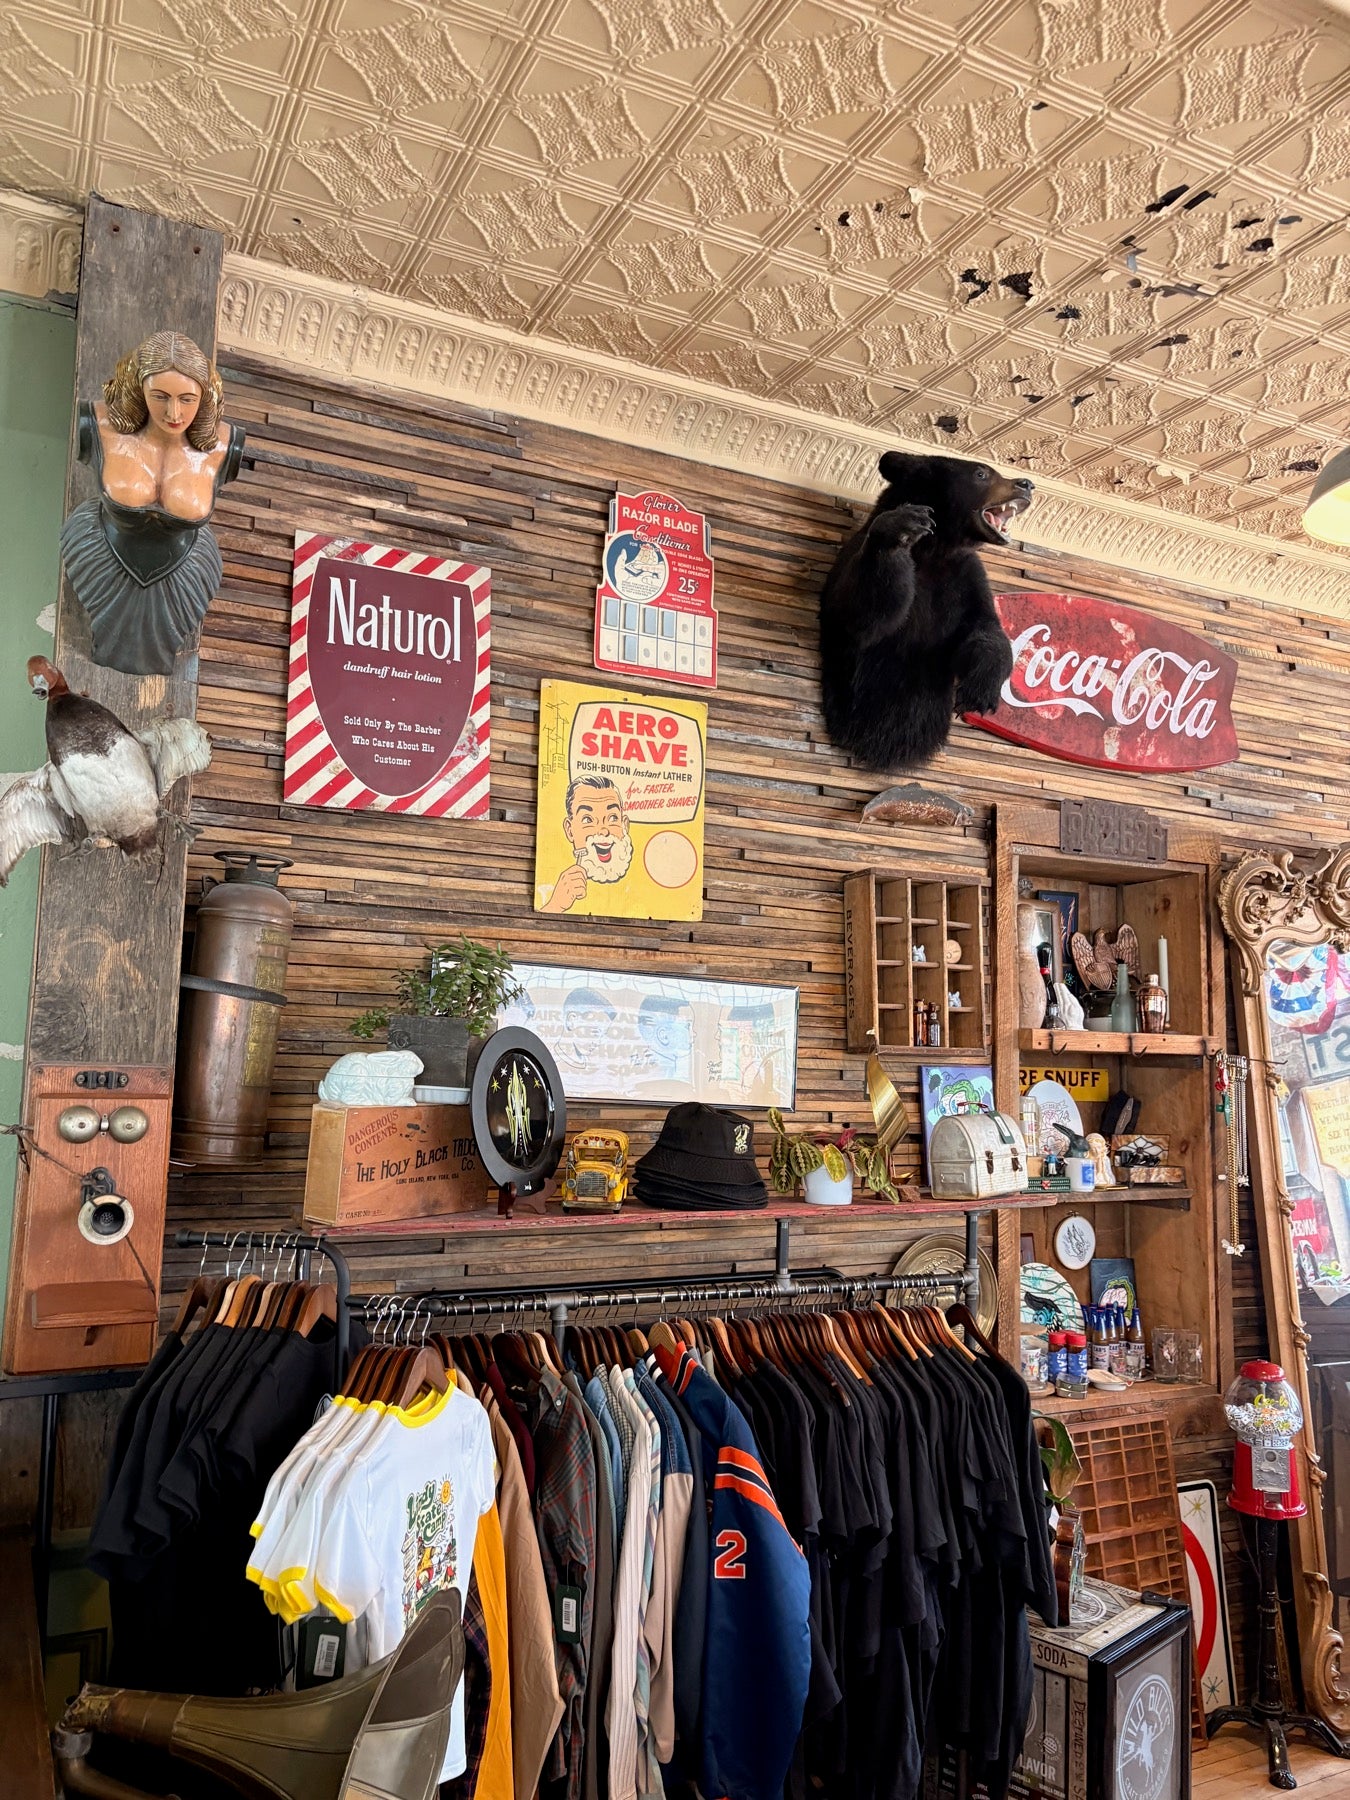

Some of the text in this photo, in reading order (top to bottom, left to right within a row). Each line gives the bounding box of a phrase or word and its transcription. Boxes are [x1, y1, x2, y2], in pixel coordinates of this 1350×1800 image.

[622, 507, 698, 534] RAZOR BLADE
[633, 524, 690, 551] Conditioner
[327, 577, 462, 662] Naturol
[343, 662, 442, 684] dandruff hair lotion
[1001, 624, 1220, 739] Coca-Cola
[344, 715, 442, 736] Sold Only By The Barber
[592, 708, 678, 739] AERO
[352, 735, 435, 753] Who Cares About His
[581, 732, 688, 767] SHAVE
[374, 754, 412, 766] Customer
[576, 760, 693, 783] PUSH-BUTTON Instant LATHER
[623, 796, 697, 812] SMOOTHER SHAVES
[626, 782, 642, 799] for
[846, 910, 856, 1018] BEVERAGES
[1044, 1070, 1100, 1088] SNUFF
[348, 1109, 400, 1146] DANGEROUS
[354, 1123, 398, 1154] CONTENTS
[356, 1162, 376, 1182] THE
[380, 1158, 411, 1180] HOLY
[415, 1145, 448, 1170] BLACK
[346, 1210, 362, 1219] CASE
[714, 1530, 747, 1579] 2
[1124, 1698, 1144, 1758] WILD
[1016, 1753, 1056, 1782] LAVOR
